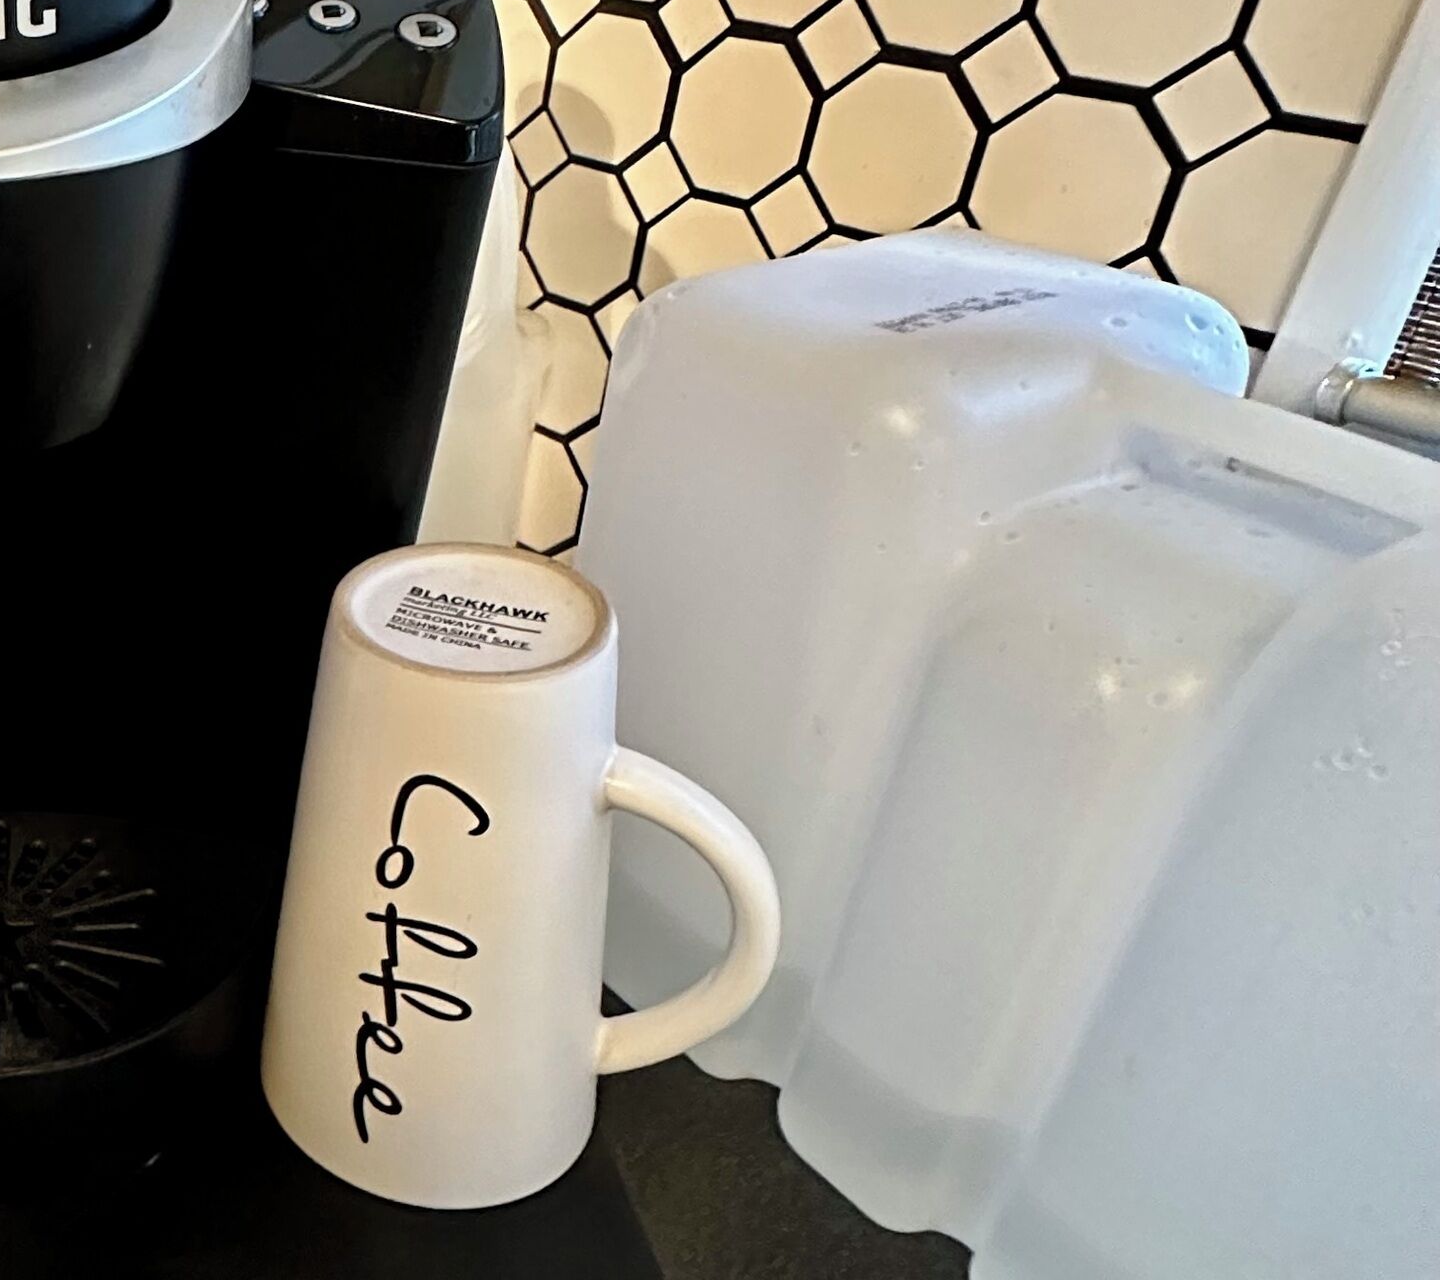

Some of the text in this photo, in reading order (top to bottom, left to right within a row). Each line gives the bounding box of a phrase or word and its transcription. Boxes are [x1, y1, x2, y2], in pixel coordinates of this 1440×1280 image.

[395, 607, 482, 631] MICROWAVE
[403, 597, 465, 617] marketing
[409, 586, 550, 622] BLACKHAWK
[385, 623, 481, 650] MADE IN CHINA
[390, 614, 531, 650] DISHWASHER SAFE
[353, 774, 490, 1143] Coffee
